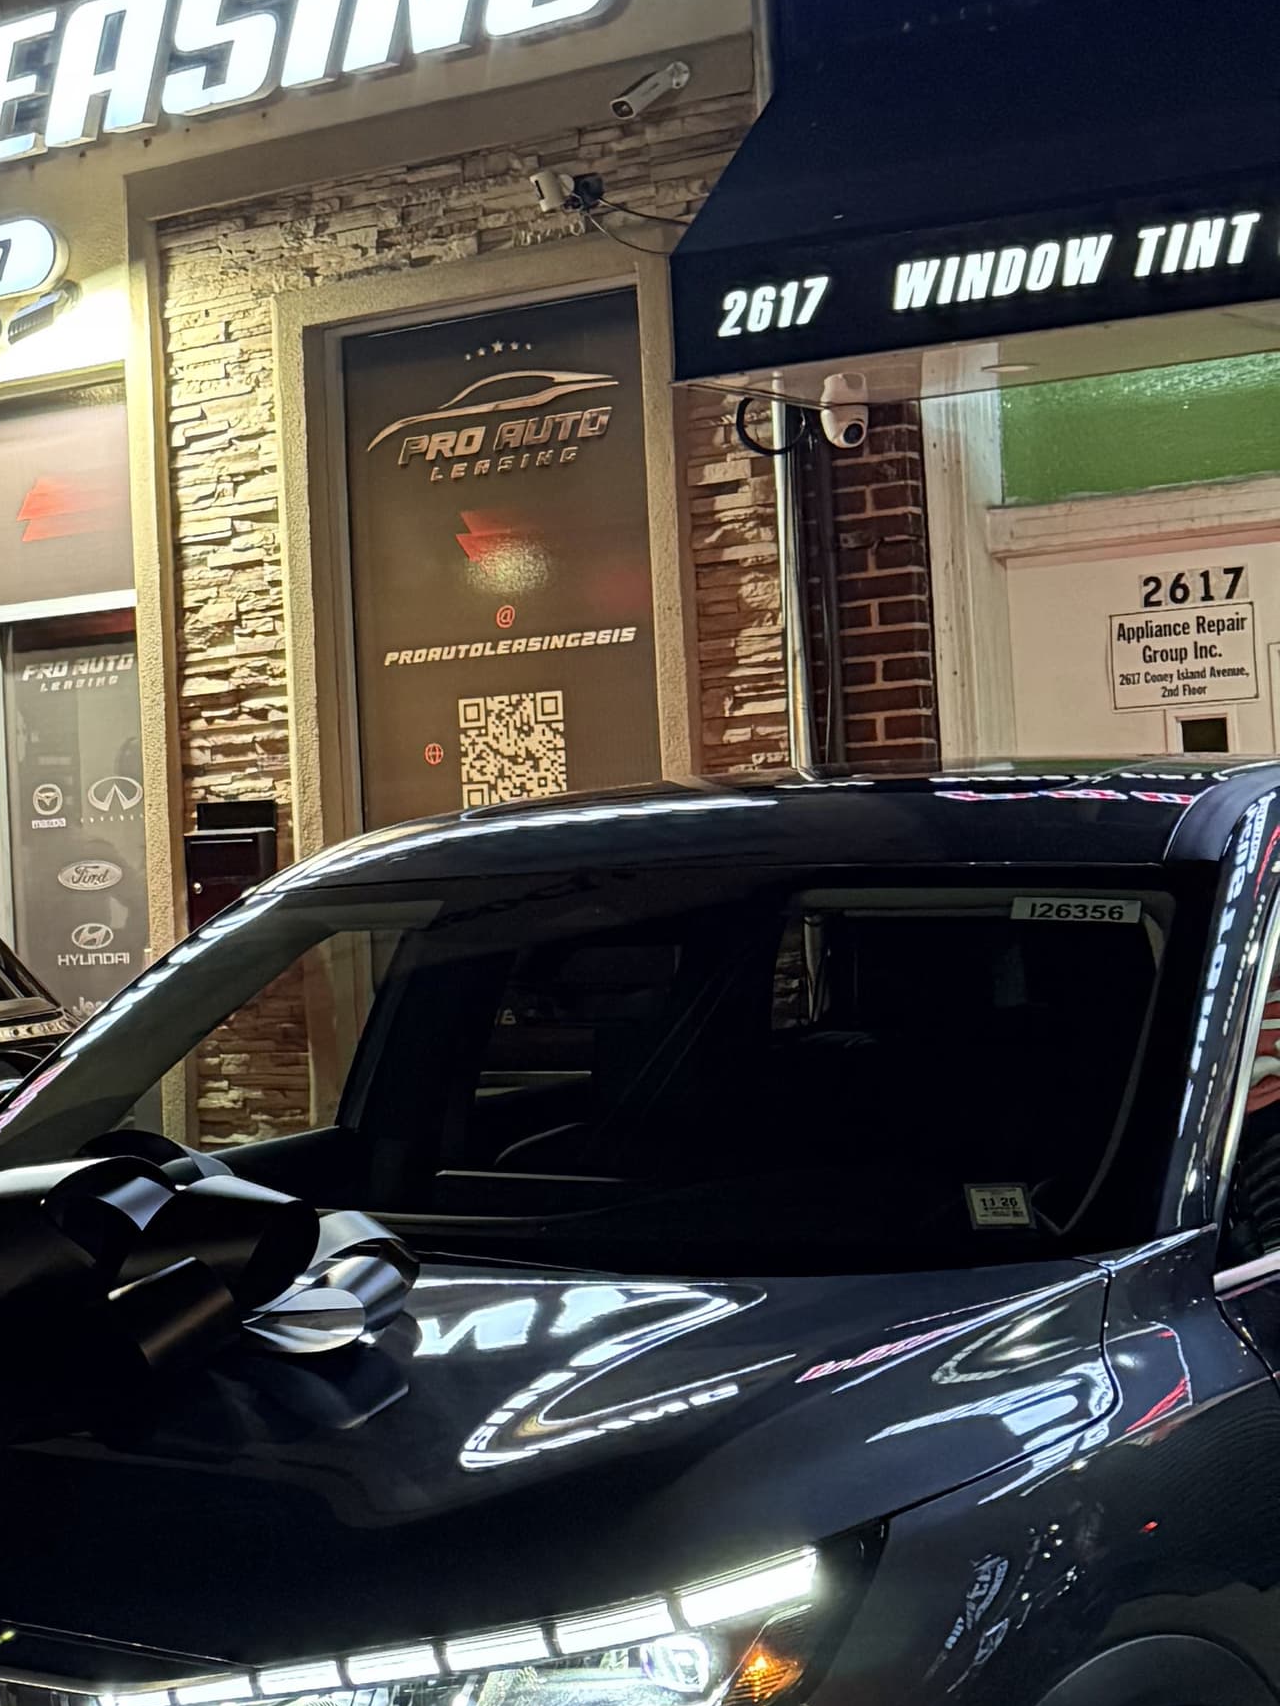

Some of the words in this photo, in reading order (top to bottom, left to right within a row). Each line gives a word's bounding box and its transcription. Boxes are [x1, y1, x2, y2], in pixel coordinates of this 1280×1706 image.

[716, 275, 830, 339] 2617
[891, 233, 1114, 312] WINDOW
[1133, 211, 1261, 278] TINT
[397, 426, 486, 466] PRO
[492, 405, 614, 455] AUTO
[429, 444, 580, 483] LEASING
[1142, 565, 1245, 608] 2617
[1116, 619, 1191, 645] Appliance
[1196, 611, 1248, 636] Repair
[383, 626, 638, 667] PROAUTOLEASING2615
[1142, 644, 1189, 665] Group
[1193, 640, 1223, 660] Inc.
[21, 660, 69, 682] PRO
[72, 653, 135, 676] AUTO
[1119, 672, 1141, 686] 2617
[1144, 670, 1174, 684] Coney
[1176, 667, 1206, 681] Island
[1161, 685, 1180, 698] 2nd
[1182, 683, 1208, 697] Floor
[70, 865, 109, 885] Ford
[57, 952, 130, 966] HYUNDAI
